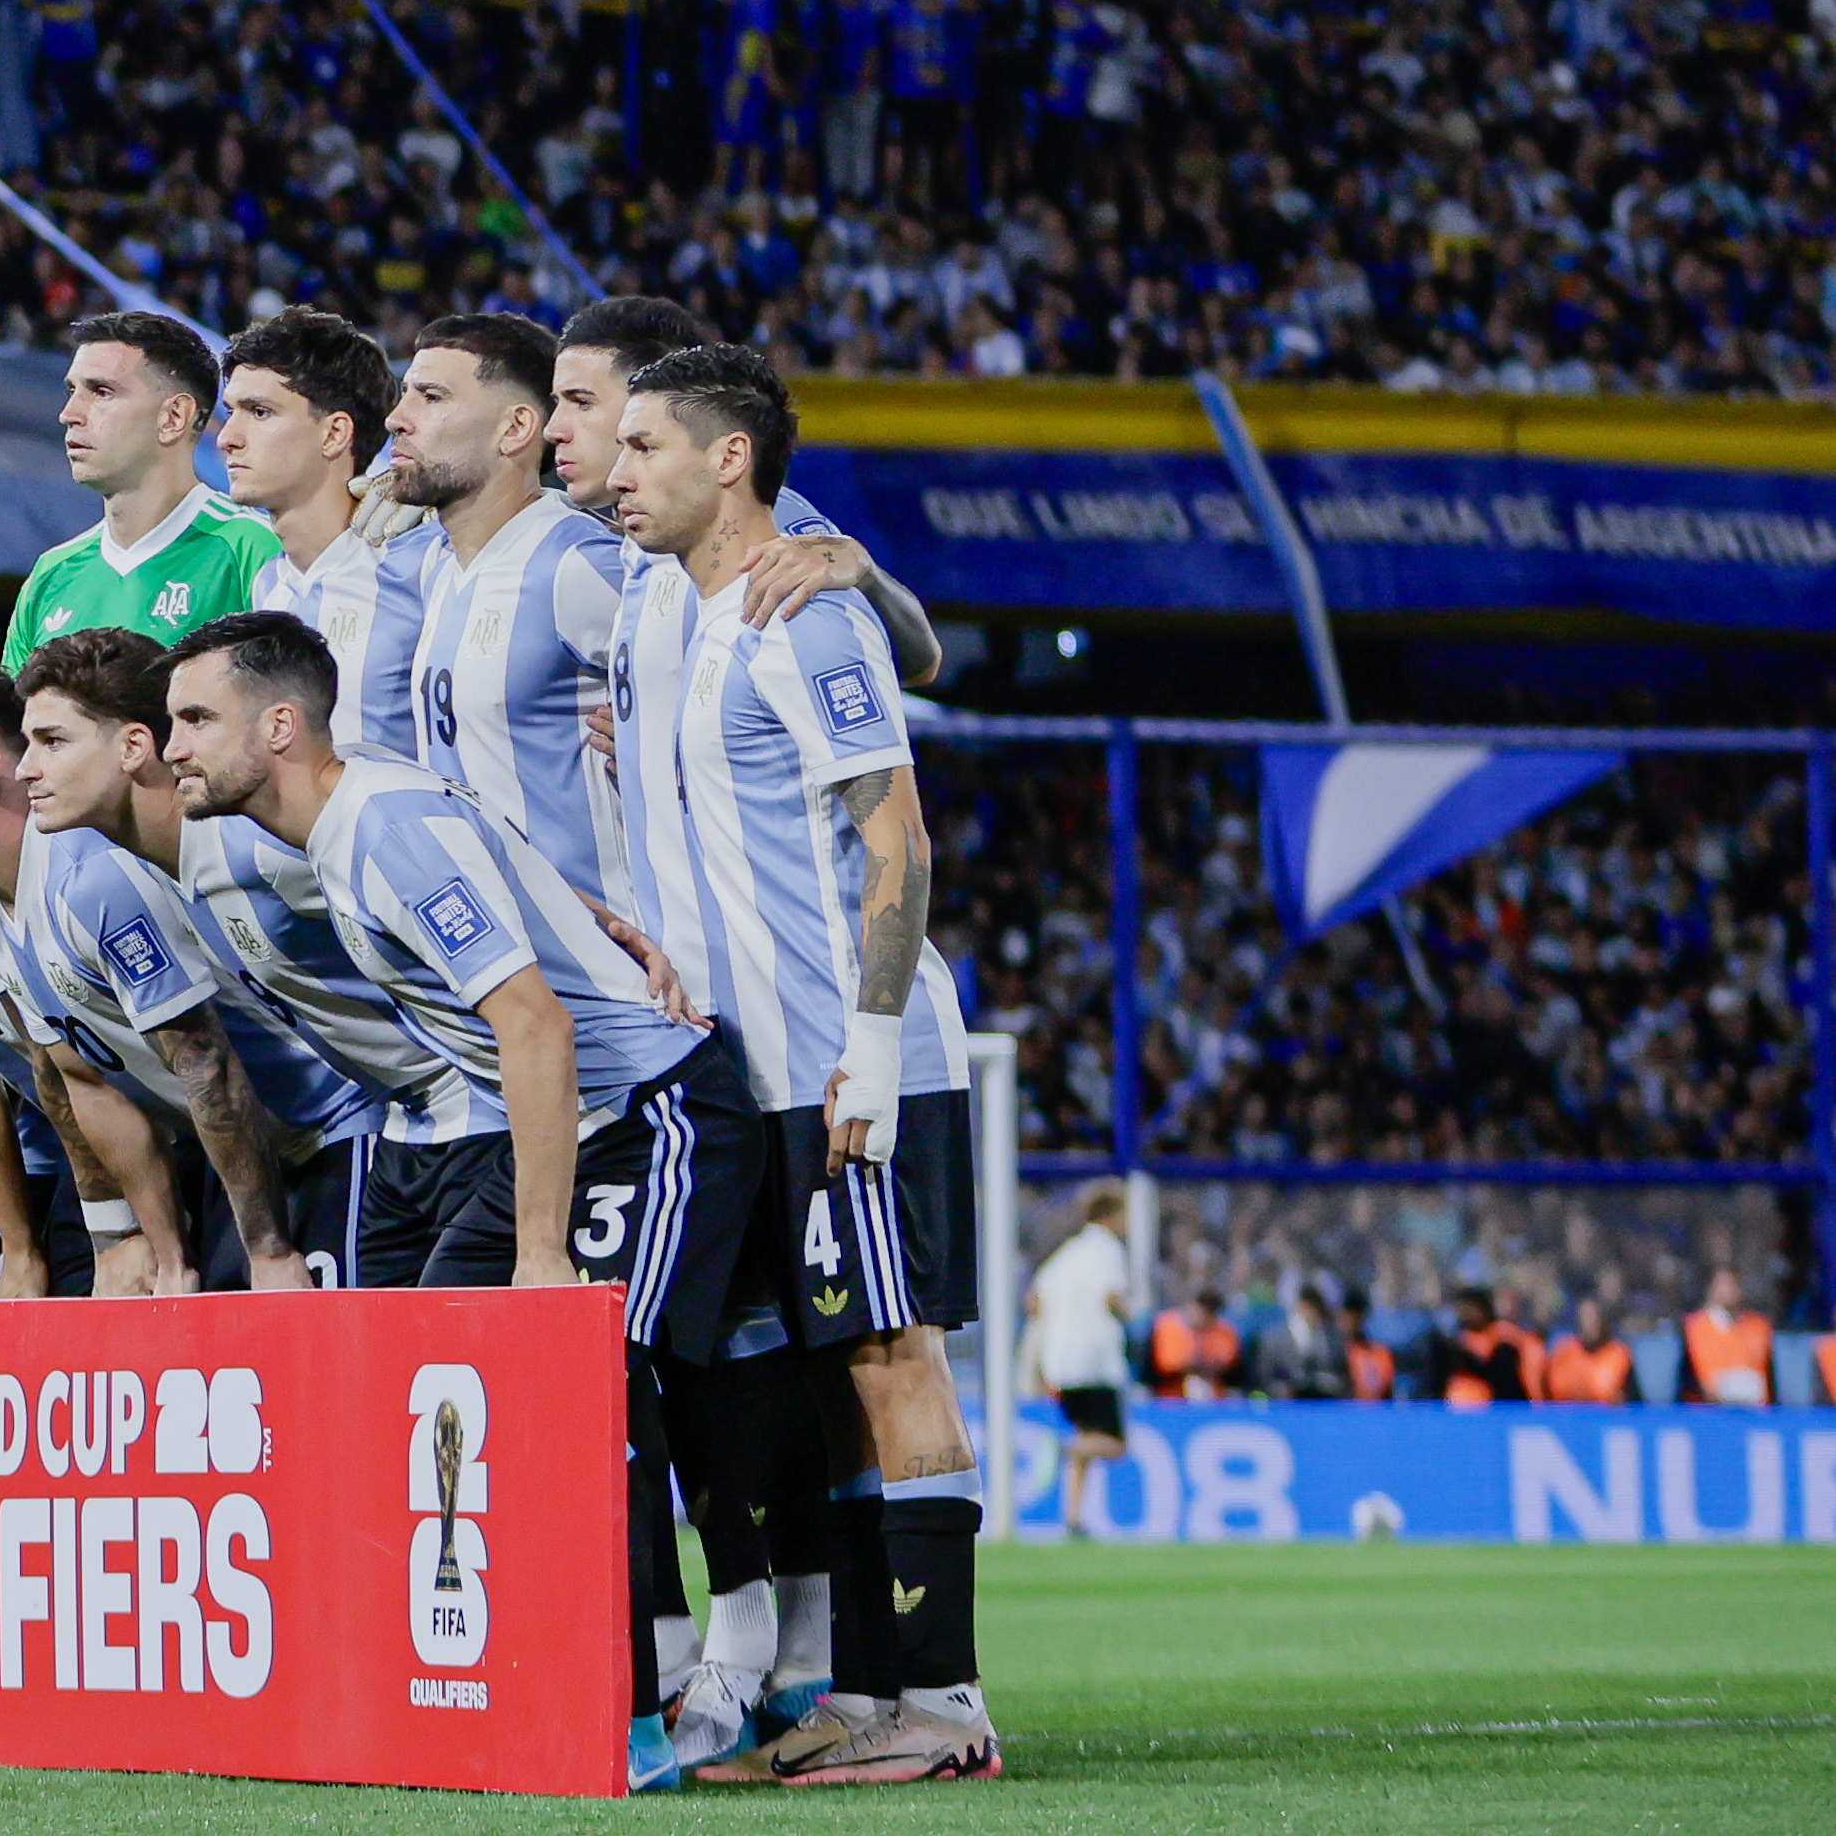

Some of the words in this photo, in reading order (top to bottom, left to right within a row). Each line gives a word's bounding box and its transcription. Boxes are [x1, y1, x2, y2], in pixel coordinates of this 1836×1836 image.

[150, 580, 192, 626] AFA
[420, 666, 458, 748] 19
[433, 900, 467, 927] UNITES
[117, 937, 148, 959] UNITES
[573, 1183, 636, 1259] 3
[803, 1188, 843, 1277] 4
[36, 1369, 146, 1478] CUP
[154, 1366, 264, 1475] 26
[432, 1606, 467, 1639] FIFA
[408, 1676, 490, 1712] QUALIFIERS
